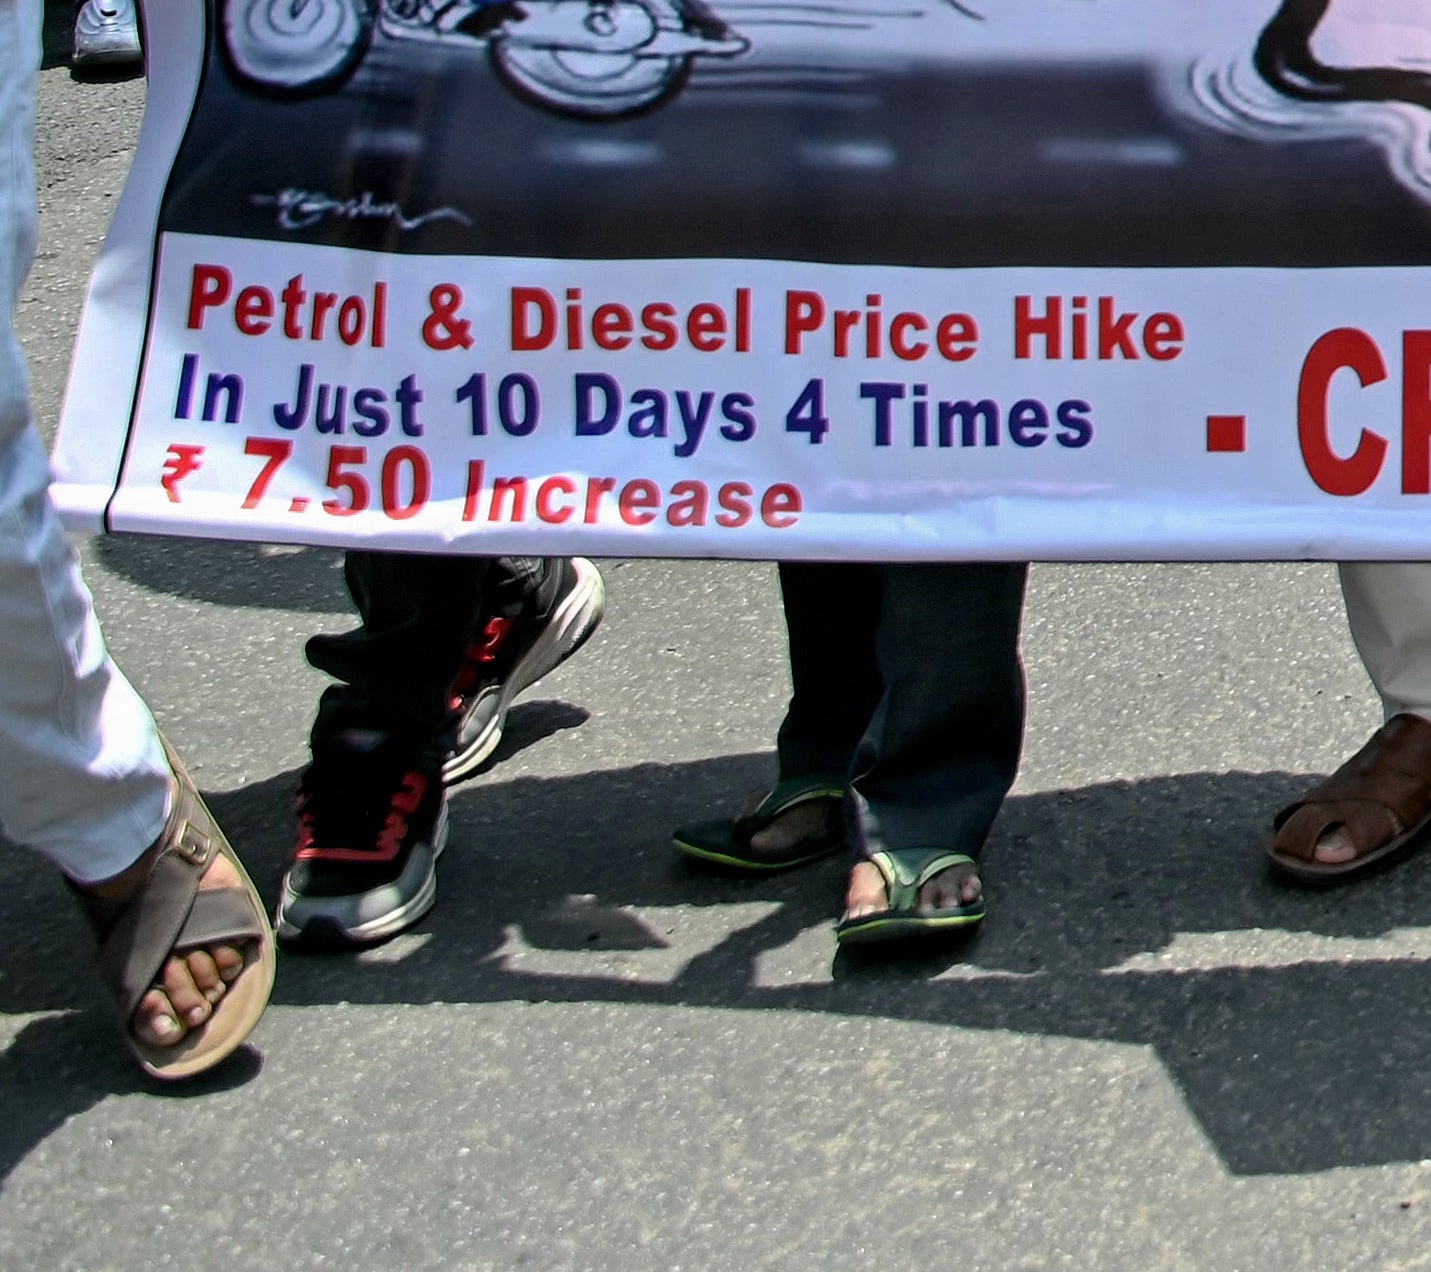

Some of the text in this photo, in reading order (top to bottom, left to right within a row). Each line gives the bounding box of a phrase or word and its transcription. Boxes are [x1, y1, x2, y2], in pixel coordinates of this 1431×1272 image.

[187, 260, 1185, 365] Petrol & Diesel Price Hike
[173, 351, 1095, 459] In Just 10 Days 4 Times
[239, 434, 803, 530] 7.50 Increase
